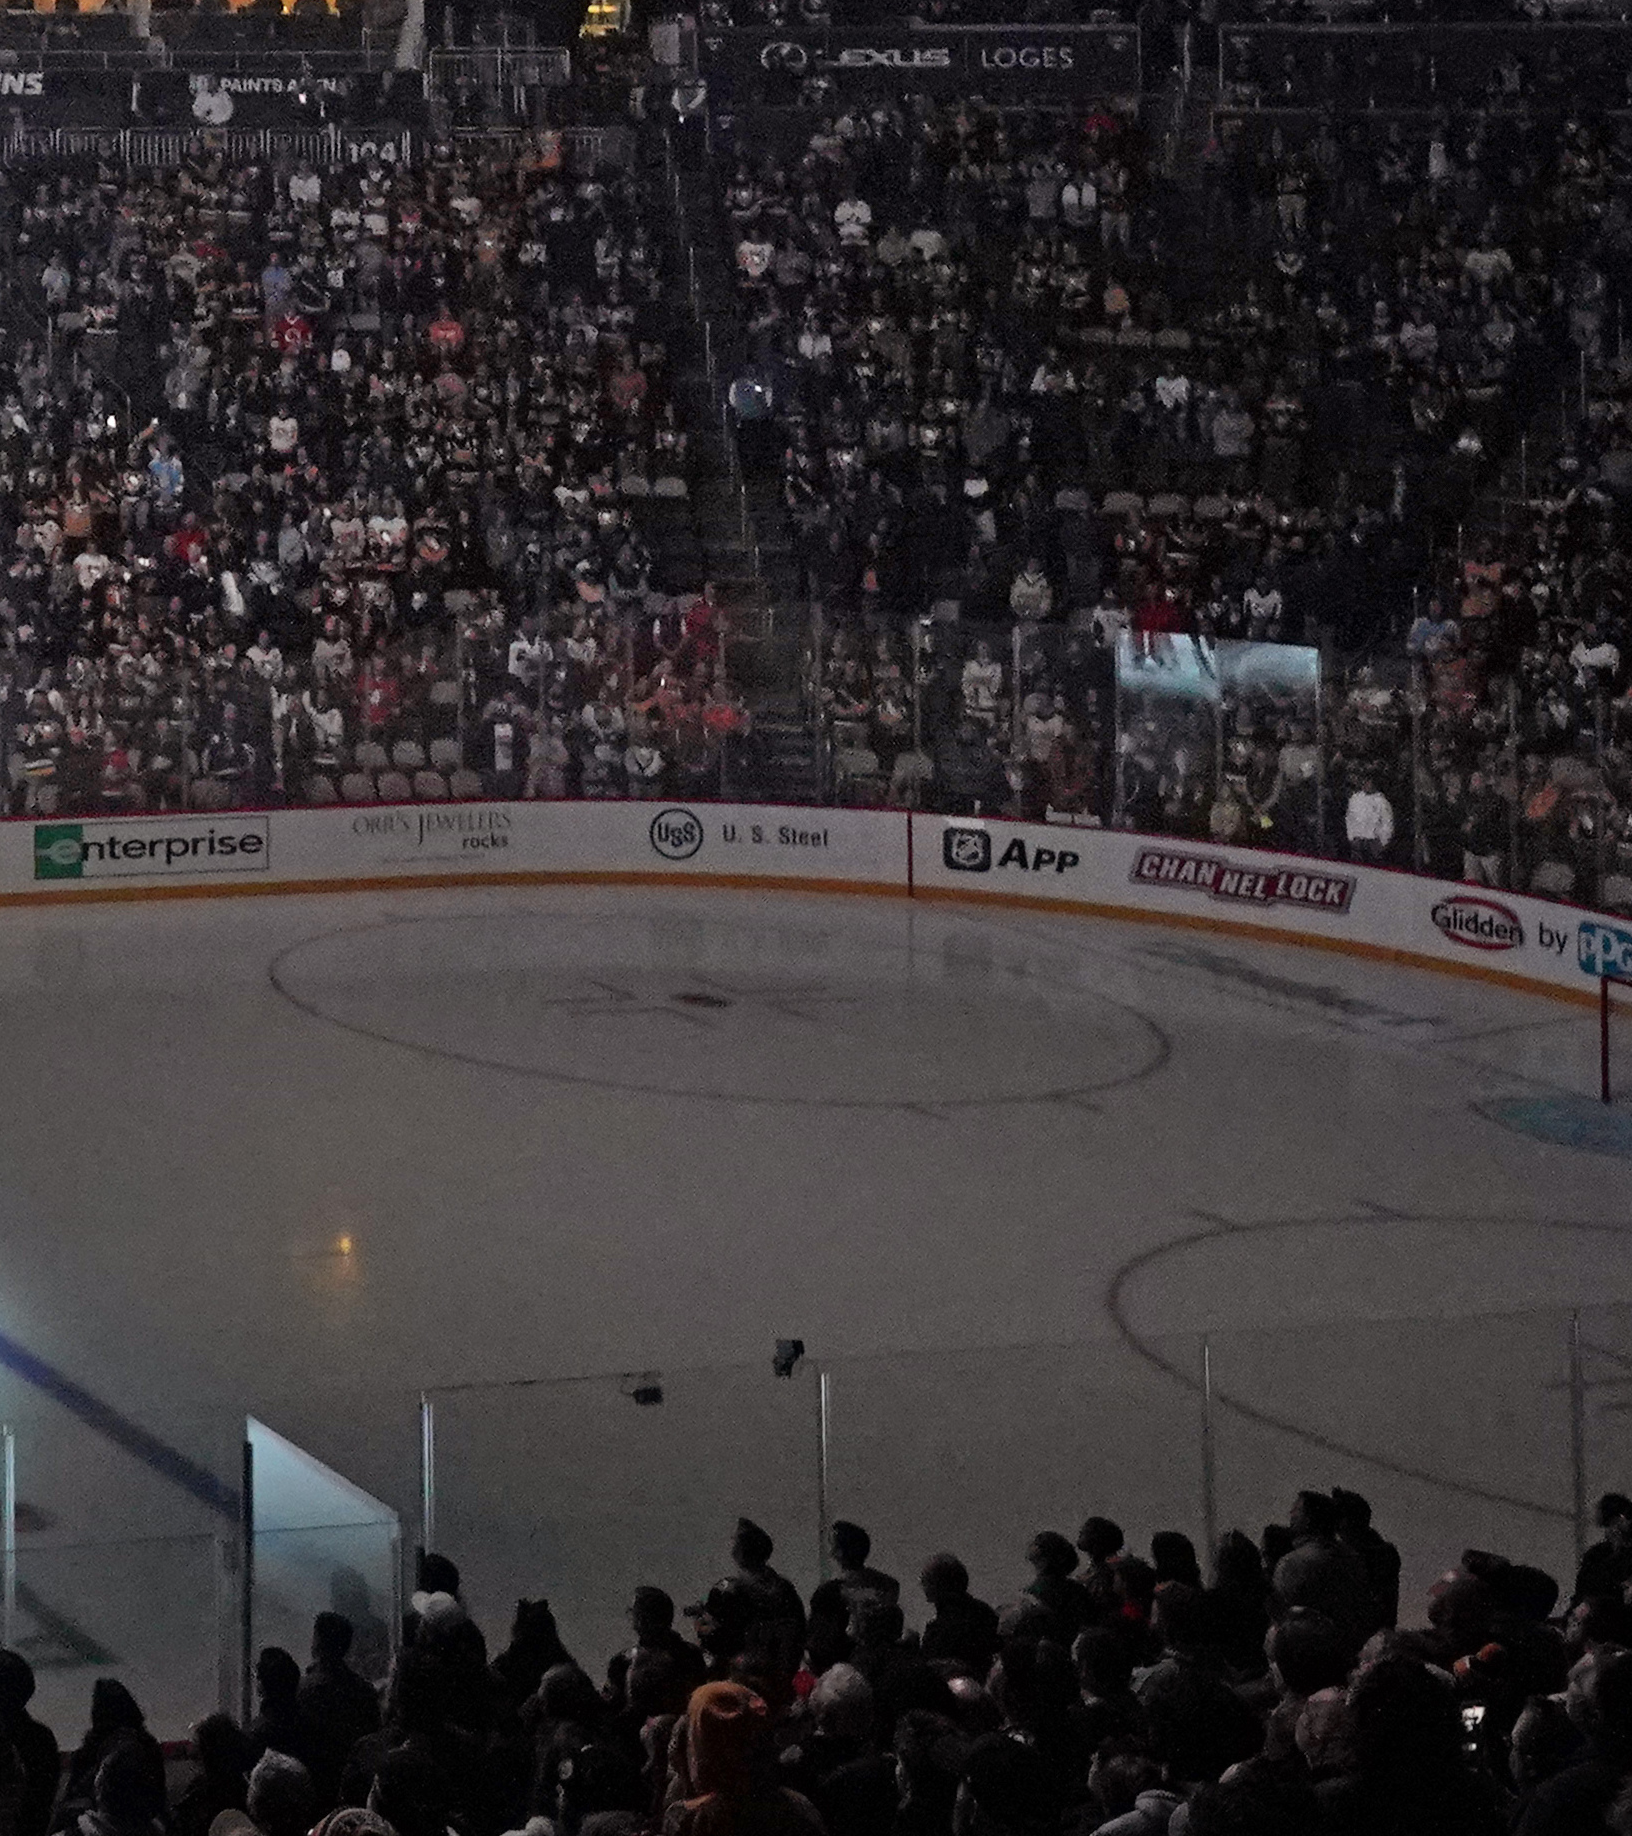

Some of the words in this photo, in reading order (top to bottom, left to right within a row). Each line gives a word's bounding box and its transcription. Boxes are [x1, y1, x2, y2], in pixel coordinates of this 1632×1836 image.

[981, 47, 1075, 69] LOGES
[51, 829, 265, 865] enterprise
[462, 833, 509, 850] rocks
[778, 825, 829, 847] Steel
[1430, 903, 1526, 948] Glidden
[1538, 921, 1569, 955] by
